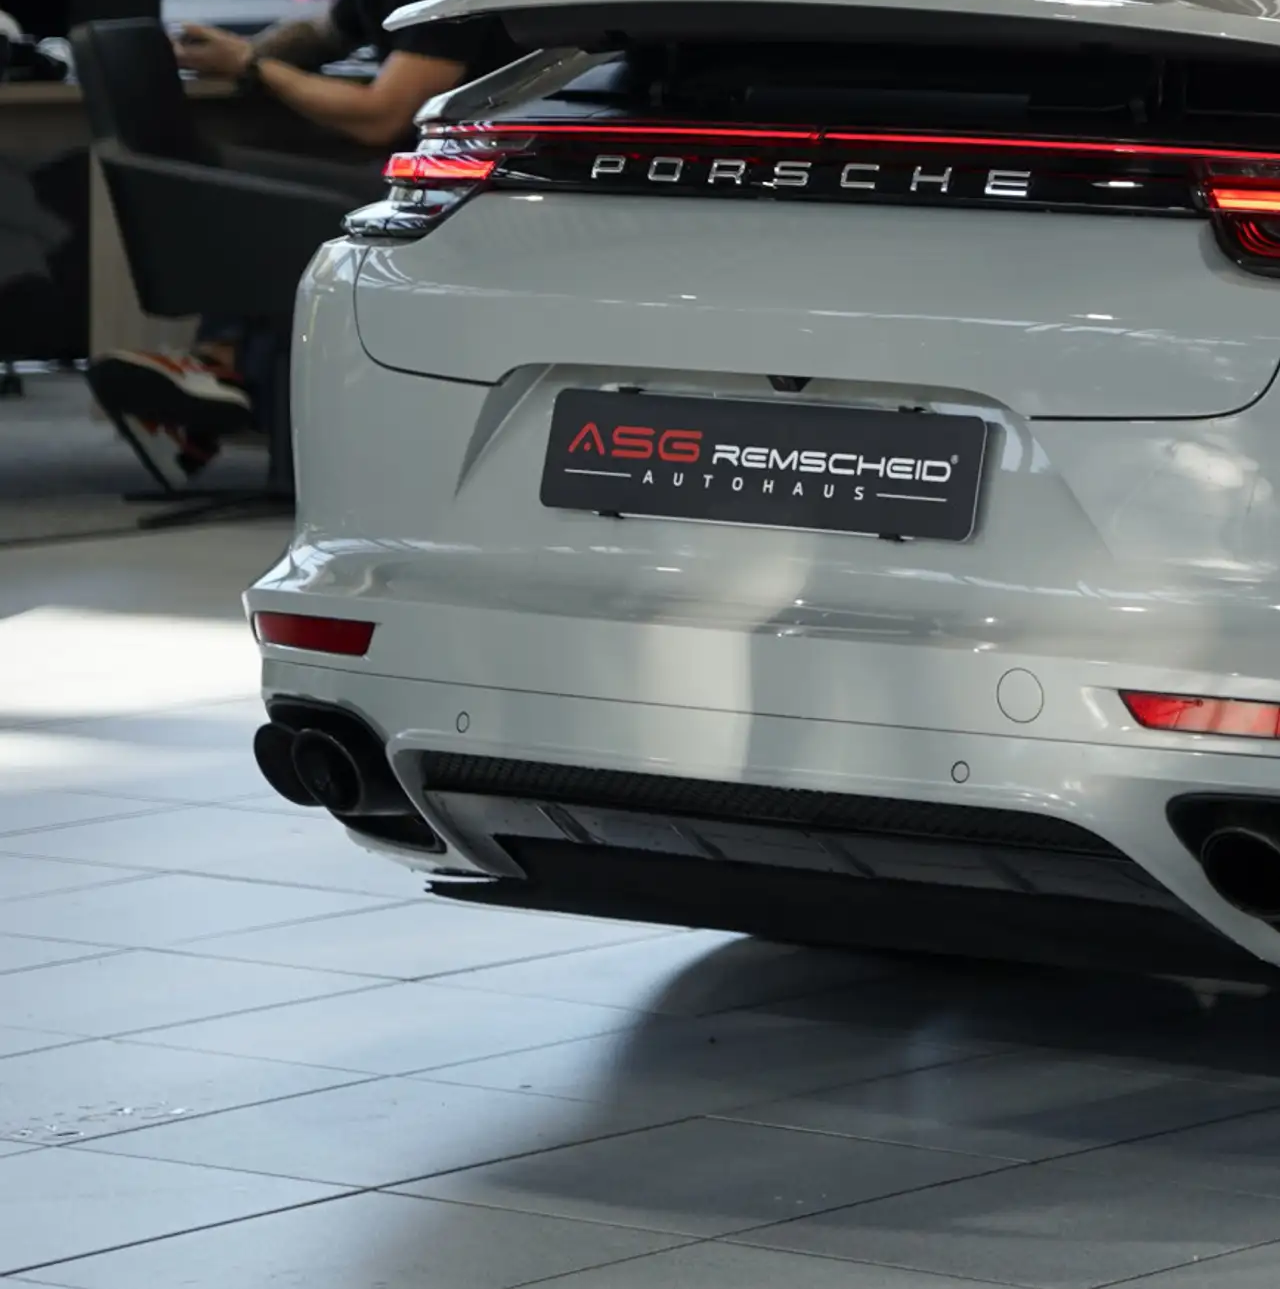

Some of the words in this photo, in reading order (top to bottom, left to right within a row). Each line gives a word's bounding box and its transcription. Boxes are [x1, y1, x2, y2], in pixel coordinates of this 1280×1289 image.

[590, 154, 1032, 197] PORSCHE
[568, 421, 703, 463] ASG
[642, 469, 865, 501] AUTOHAUS
